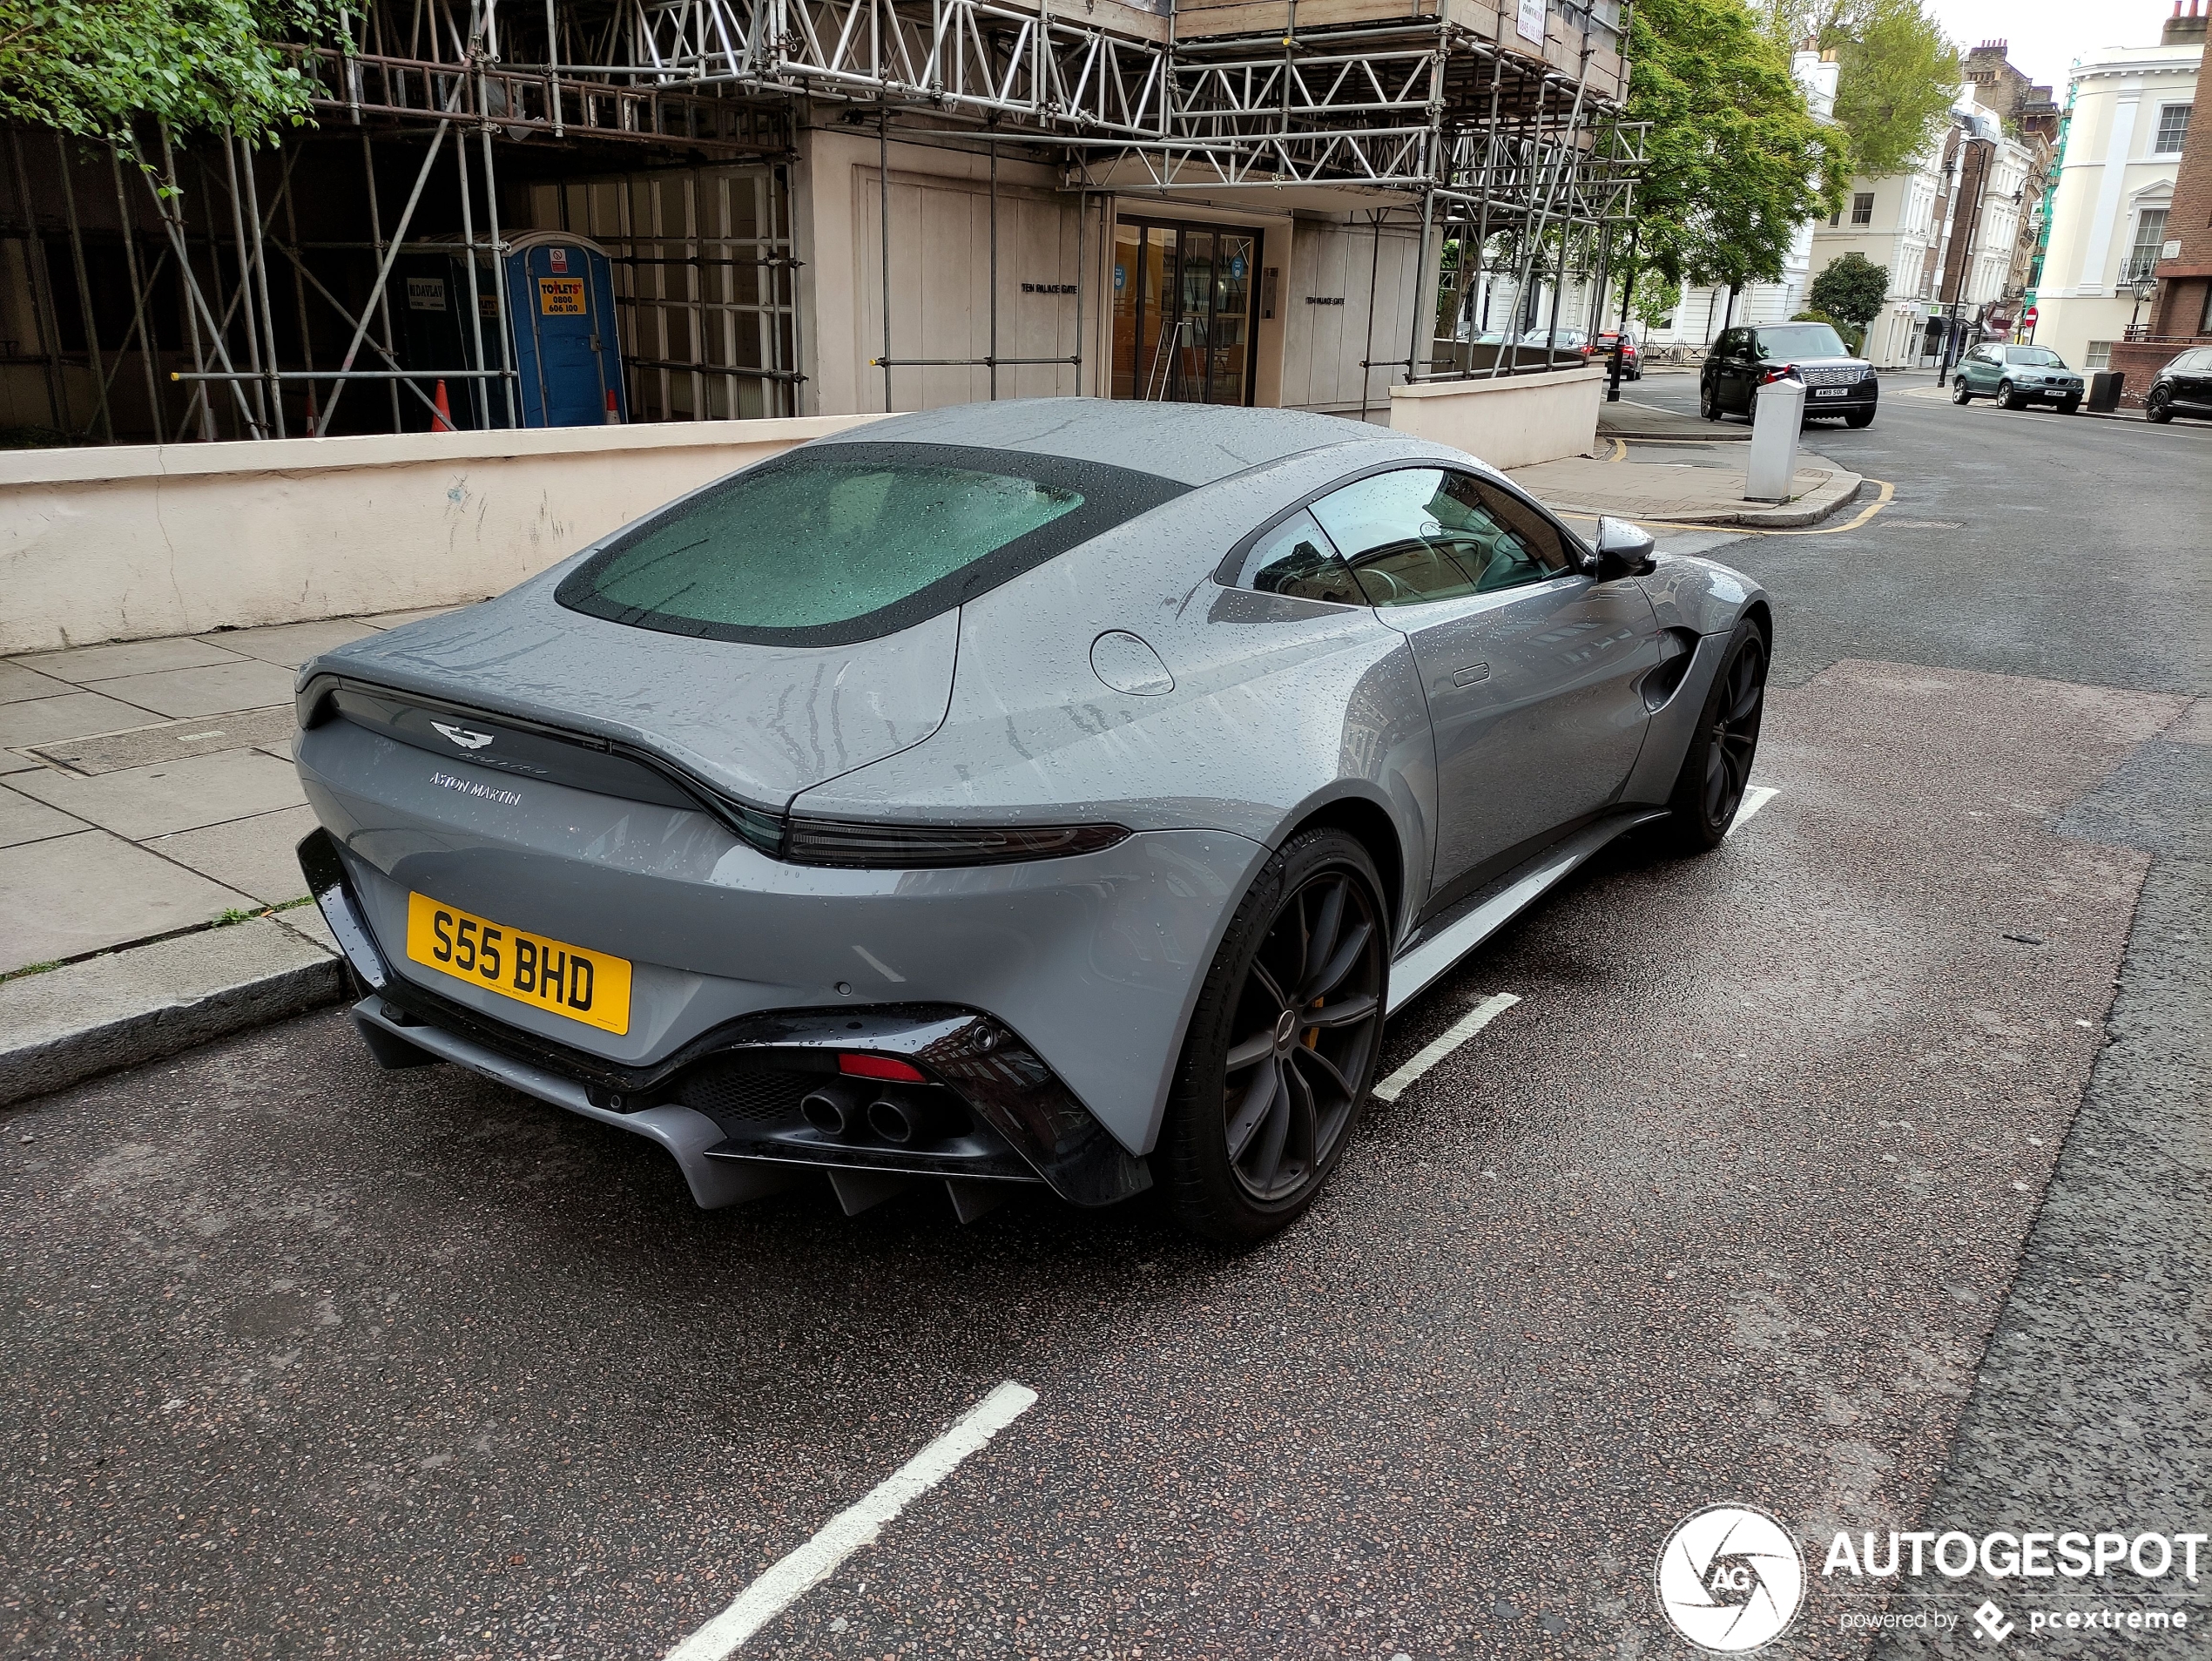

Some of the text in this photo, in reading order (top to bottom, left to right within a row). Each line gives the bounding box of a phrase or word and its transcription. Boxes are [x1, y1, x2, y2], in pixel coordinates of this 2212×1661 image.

[1021, 283, 1078, 294] TEN PALACE GATE
[429, 772, 522, 807] ASTON MARTIN
[433, 910, 595, 1012] S55 BHD
